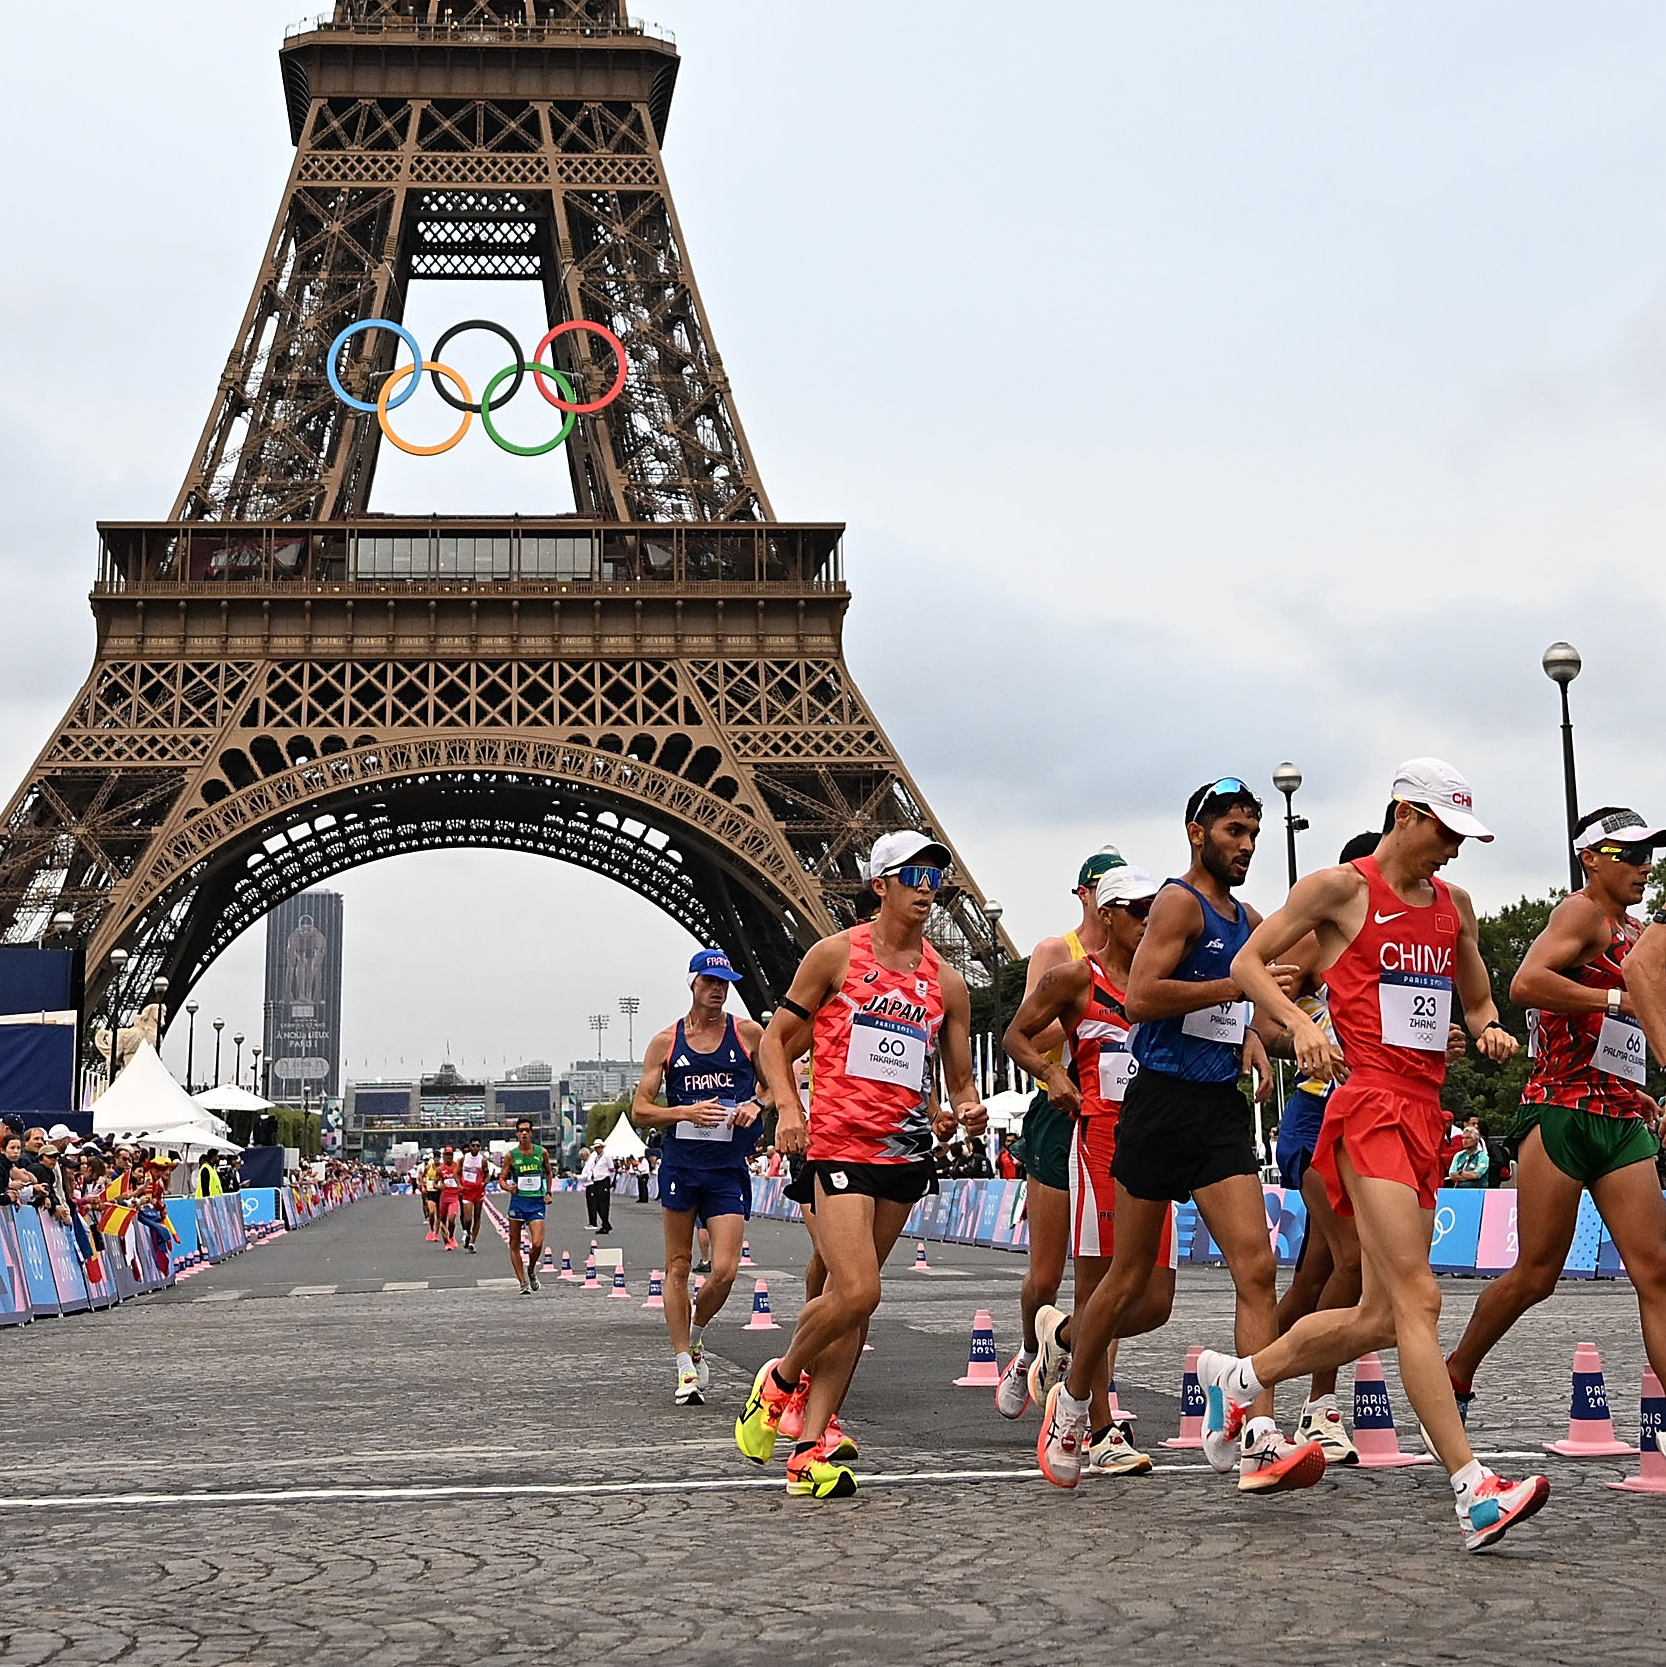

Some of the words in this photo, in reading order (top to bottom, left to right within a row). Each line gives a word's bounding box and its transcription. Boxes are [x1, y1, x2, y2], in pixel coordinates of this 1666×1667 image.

[1452, 792, 1472, 807] CHI
[862, 995, 927, 1023] JAPAN
[1413, 995, 1436, 1017] 23
[874, 1019, 895, 1030] PARIS
[878, 1037, 905, 1056] 60
[1626, 1033, 1640, 1053] 66
[1602, 1045, 1628, 1061] PALMA
[869, 1053, 909, 1070] TAKAHASHI
[684, 1072, 734, 1092] FRANCE
[519, 1163, 539, 1173] BRASIL
[1188, 1396, 1204, 1405] 20
[1588, 1397, 1607, 1408] 20
[1356, 1406, 1389, 1417] 2024
